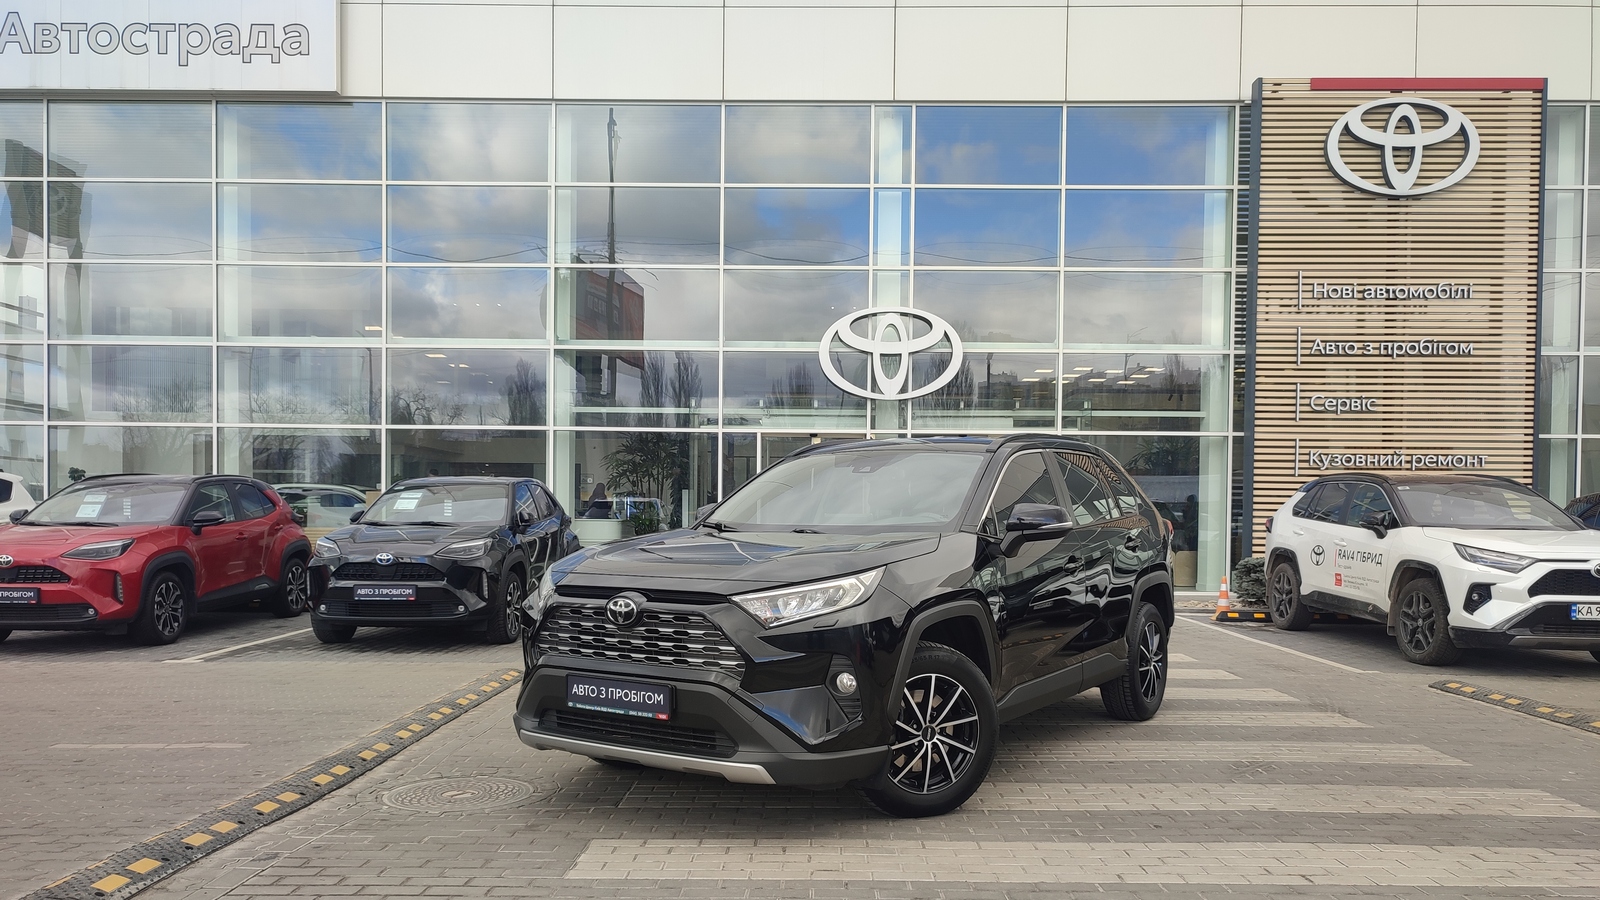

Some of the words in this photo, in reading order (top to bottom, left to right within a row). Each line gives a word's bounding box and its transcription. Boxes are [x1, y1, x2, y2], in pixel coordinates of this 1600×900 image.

[0, 11, 310, 67] Автострада
[1312, 282, 1358, 299] Нові
[1363, 281, 1474, 299] автомобілі
[1310, 338, 1358, 355] Авто
[1362, 341, 1374, 355] з
[1380, 338, 1474, 360] пробігом
[1309, 394, 1378, 416] Сервіс
[1308, 450, 1406, 471] Кузовний
[1411, 454, 1489, 471] ремонт
[1338, 549, 1355, 561] RAV4
[1356, 551, 1383, 567] ГІБРИД
[572, 683, 597, 697] АВТО
[599, 687, 606, 699] З
[608, 688, 664, 705] ПРОБІГОМ
